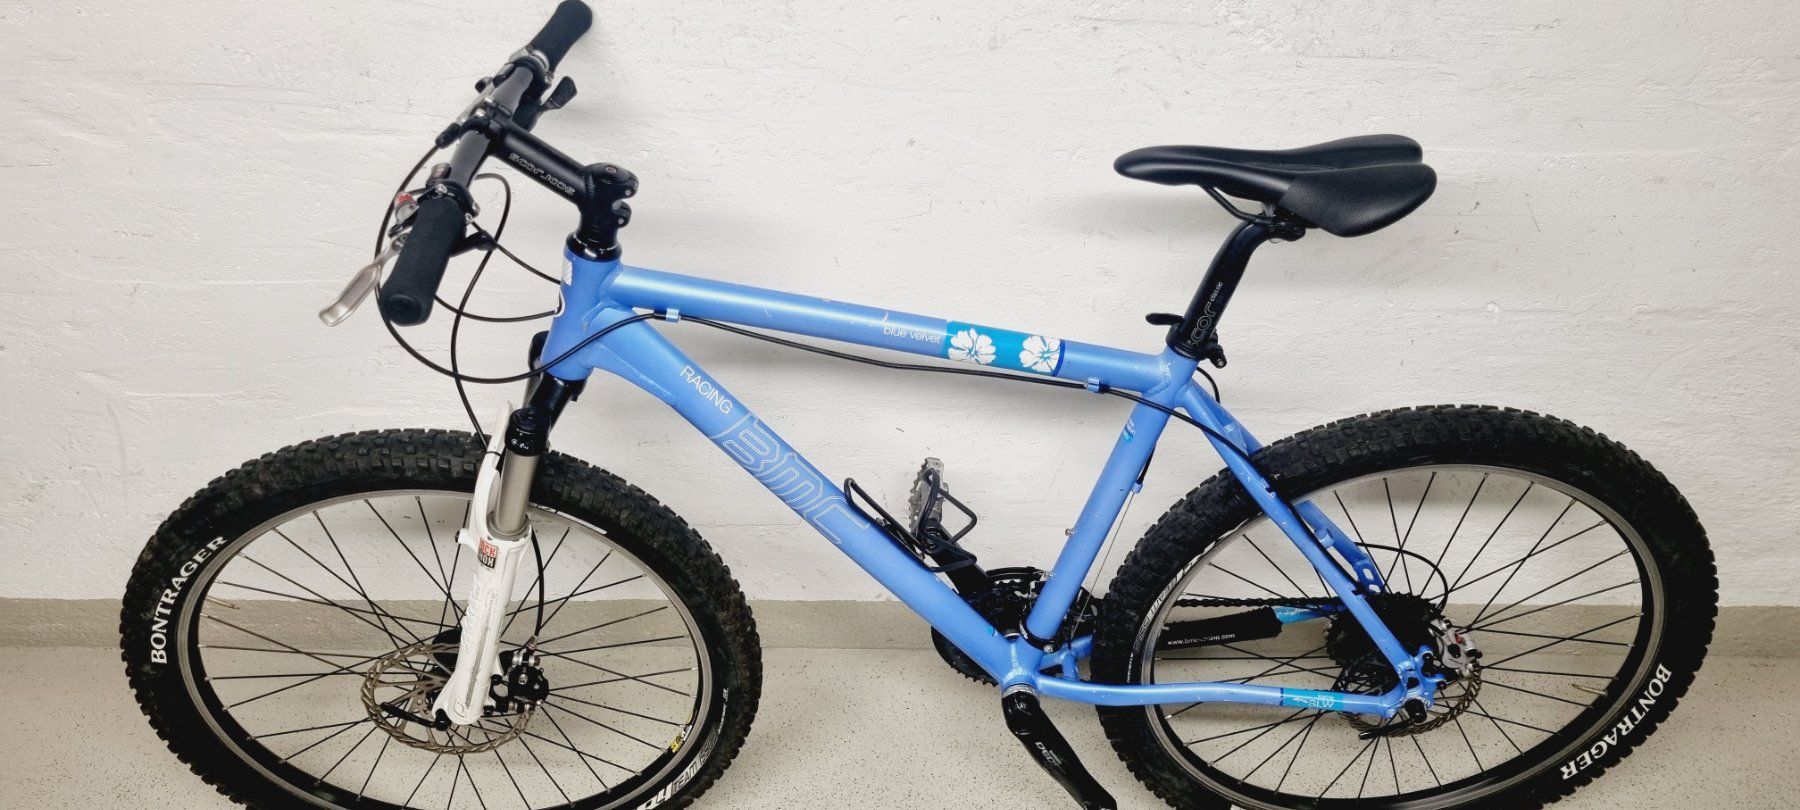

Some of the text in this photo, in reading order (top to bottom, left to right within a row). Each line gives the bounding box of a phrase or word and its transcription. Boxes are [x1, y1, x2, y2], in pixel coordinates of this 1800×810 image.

[679, 365, 733, 415] RACING
[883, 325, 941, 344] blue velvet
[710, 412, 871, 545] BMC
[150, 536, 228, 664] BONTRAGER
[1559, 663, 1672, 780] BONTRAGER
